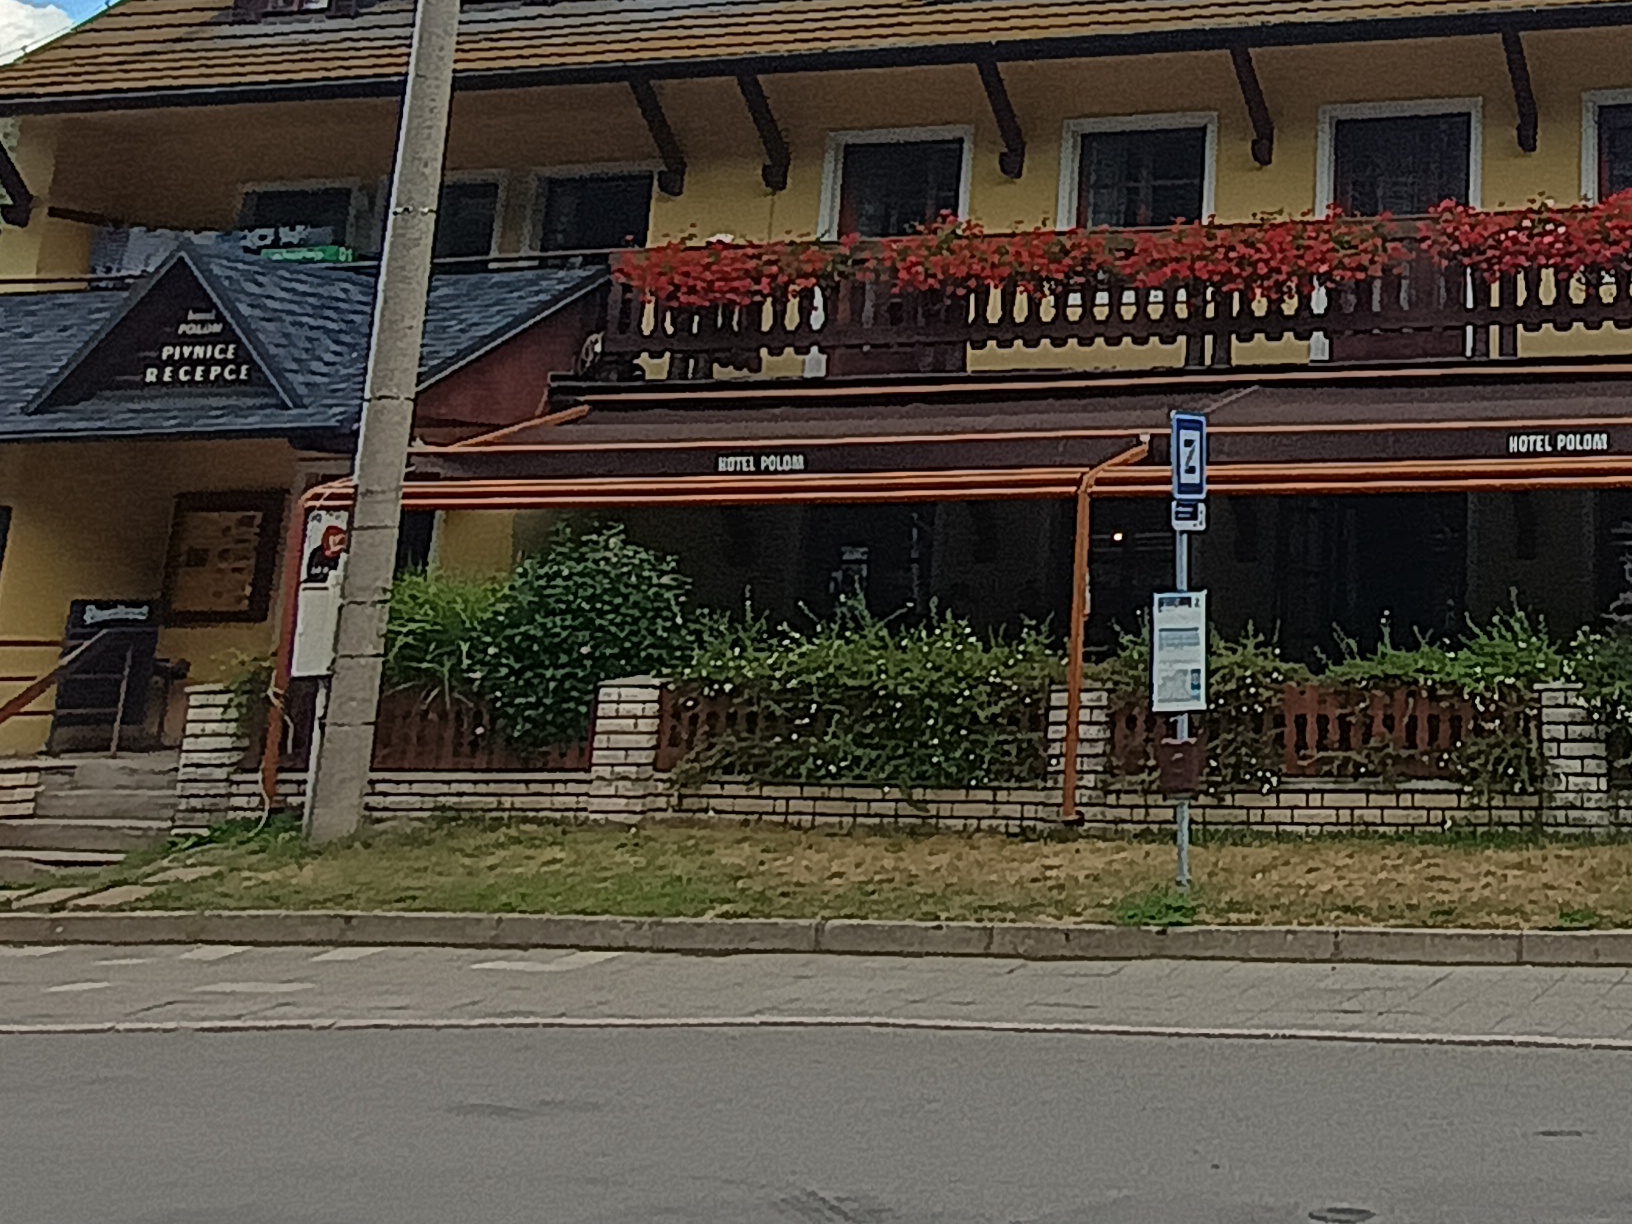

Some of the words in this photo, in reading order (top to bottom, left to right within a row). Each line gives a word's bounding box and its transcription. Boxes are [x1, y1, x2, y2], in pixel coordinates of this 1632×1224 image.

[161, 343, 237, 361] PIVNICE
[144, 364, 250, 383] RECEPCE
[1508, 434, 1553, 453] HOTEL
[1556, 433, 1608, 451] POLOM
[718, 456, 756, 472] HOTEL
[760, 454, 805, 472] POLOM
